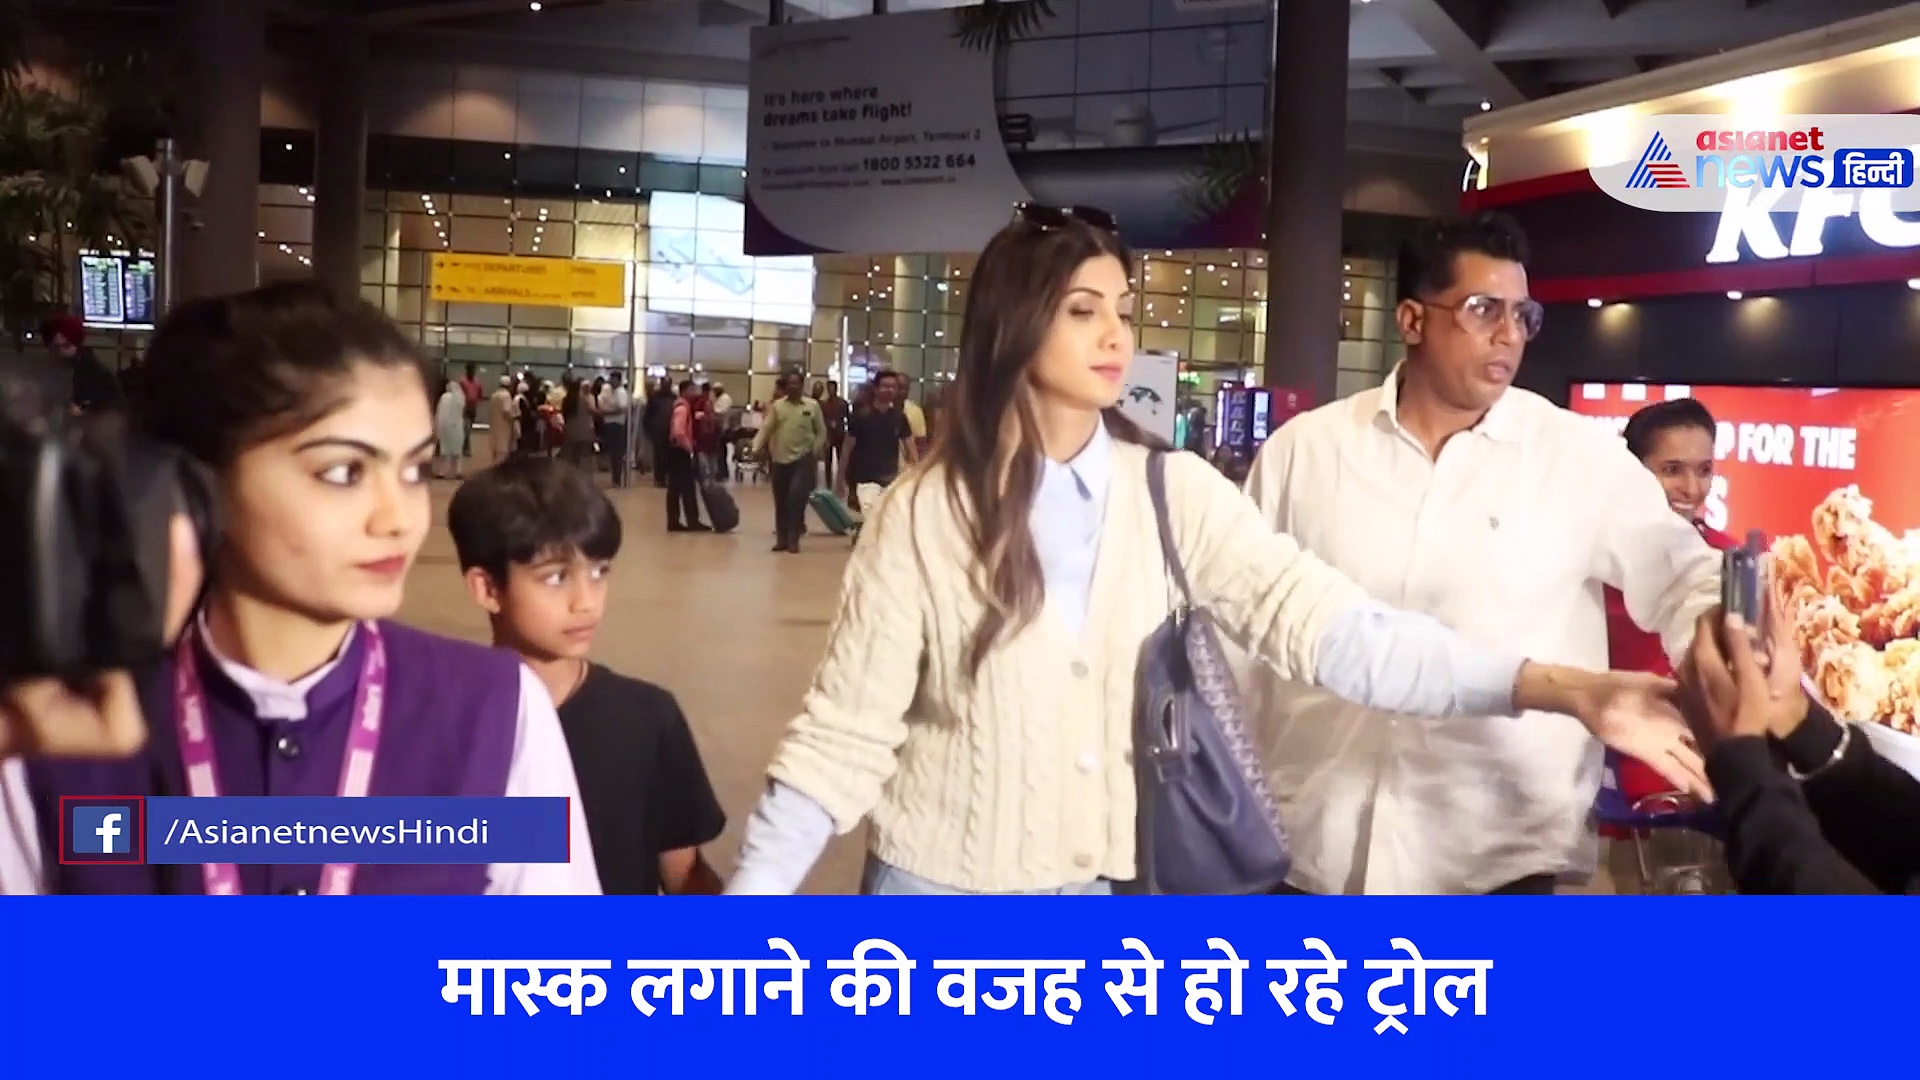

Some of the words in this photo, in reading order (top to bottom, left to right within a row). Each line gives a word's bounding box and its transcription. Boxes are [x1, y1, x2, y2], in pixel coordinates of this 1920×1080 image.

[790, 89, 825, 105] here
[829, 85, 879, 102] where
[763, 111, 818, 127] dreams
[822, 106, 857, 122] take
[862, 102, 912, 121] flight!
[862, 155, 900, 171] 1800
[904, 154, 941, 170] 5322
[945, 153, 977, 168] 664
[1737, 422, 1795, 466] FOR
[1799, 425, 1857, 470] THE
